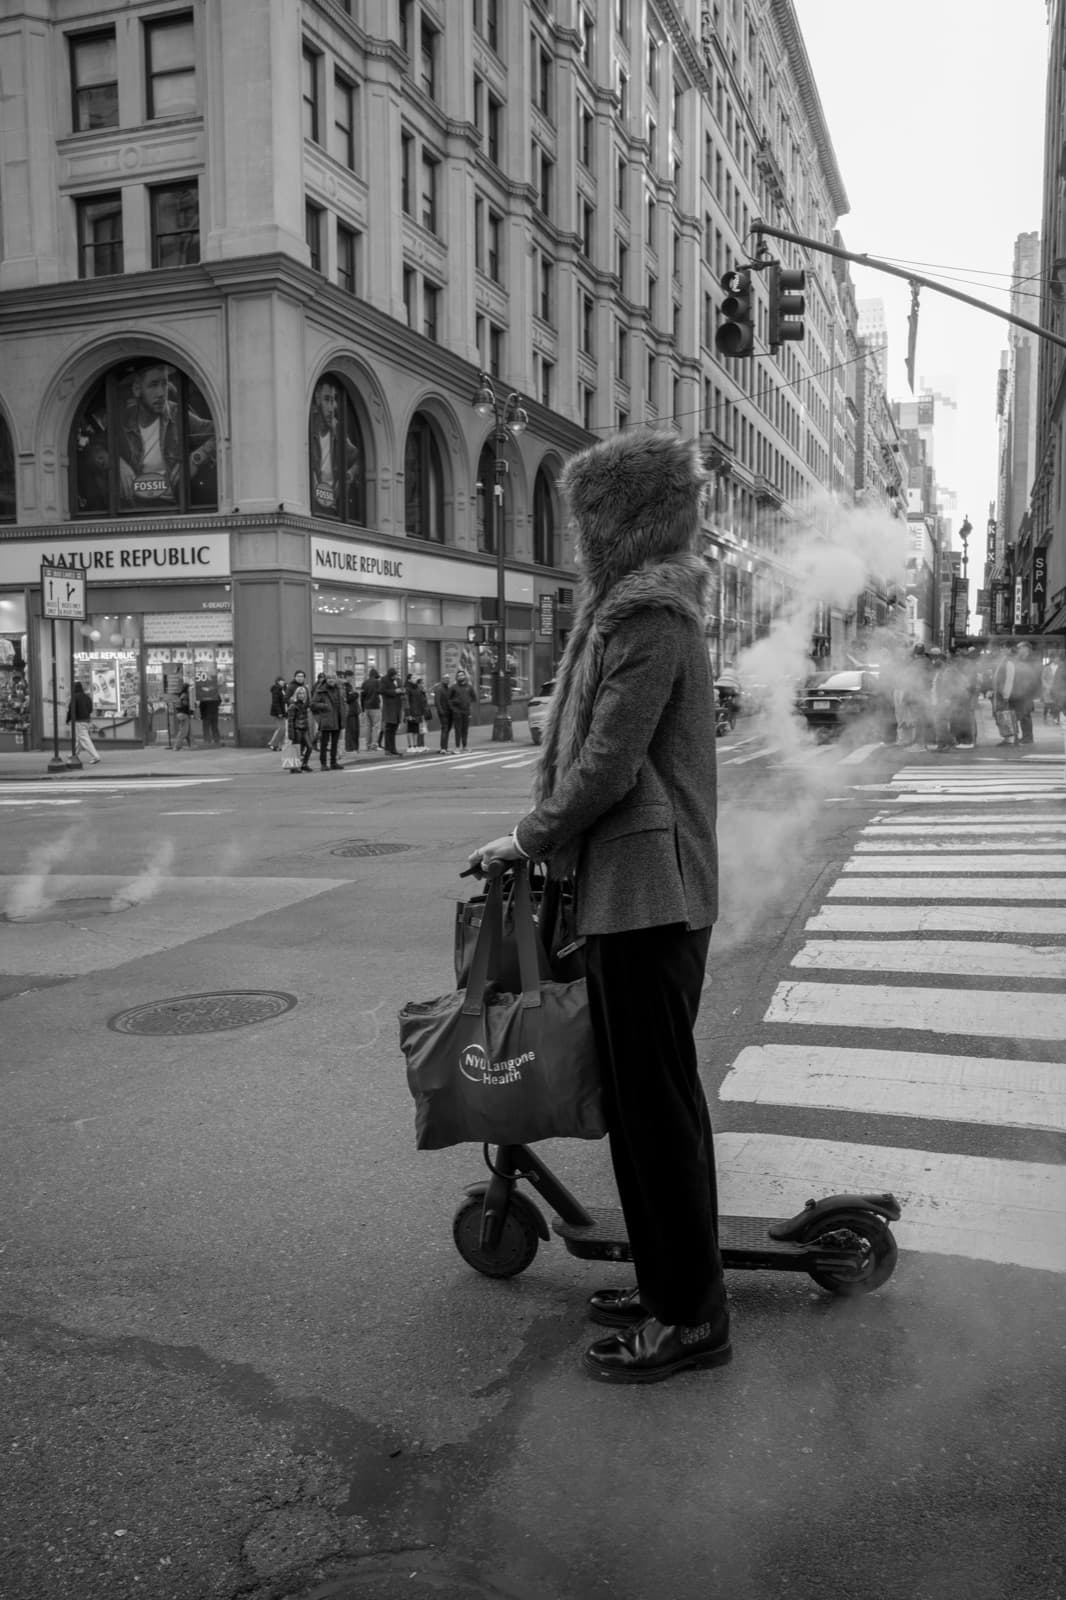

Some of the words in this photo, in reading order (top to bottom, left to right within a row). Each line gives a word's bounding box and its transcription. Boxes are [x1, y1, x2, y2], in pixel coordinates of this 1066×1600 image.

[134, 480, 168, 491] FOSSIL
[316, 489, 334, 500] FOSSIL
[42, 551, 114, 569] NATURE
[120, 546, 210, 567] REPUBLIC
[315, 548, 358, 572] NATURE
[360, 556, 403, 578] REPUBLIC
[1034, 558, 1044, 592] SPA
[465, 1053, 486, 1070] NYU
[487, 1051, 536, 1073] Langone
[483, 1070, 522, 1085] Health
